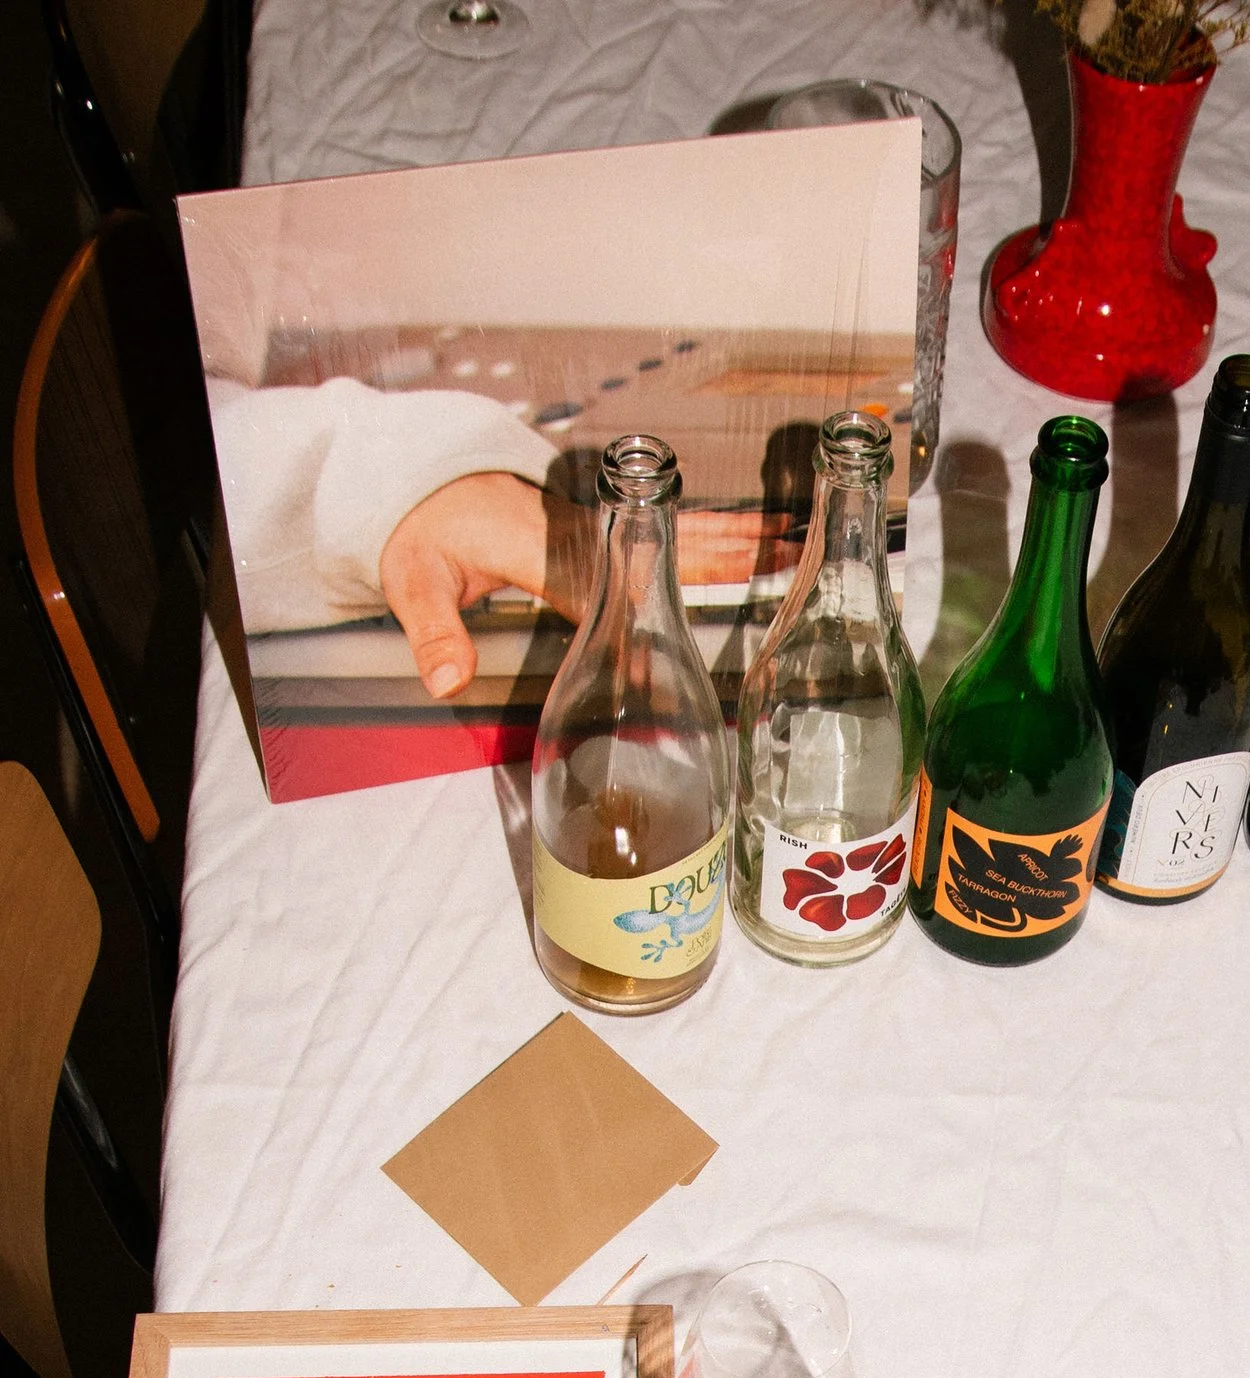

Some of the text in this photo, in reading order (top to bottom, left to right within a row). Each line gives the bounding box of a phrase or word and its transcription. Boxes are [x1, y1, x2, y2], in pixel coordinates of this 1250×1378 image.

[780, 834, 808, 850] RISH
[1017, 853, 1049, 881] APRICOT
[957, 873, 1017, 903] TARRAGON
[985, 869, 1068, 900] SEA BUCKTHORN
[948, 889, 973, 915] FIZZY
